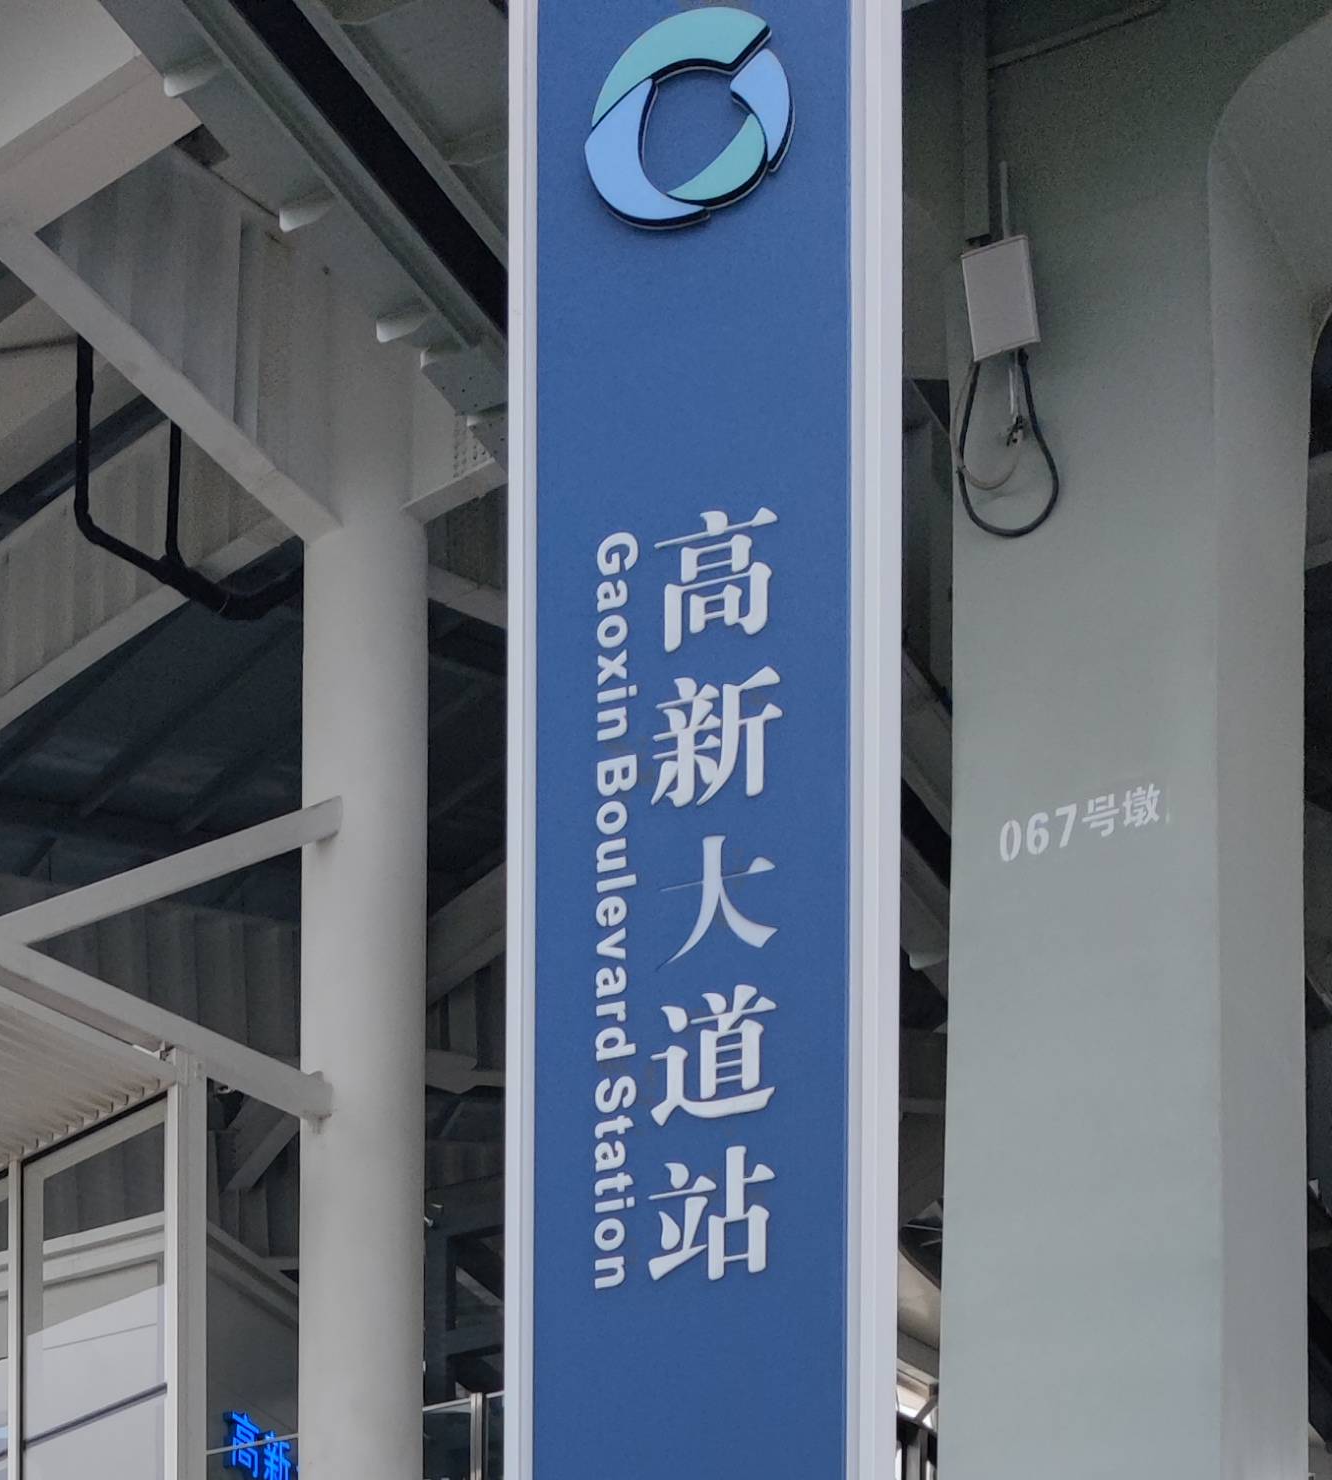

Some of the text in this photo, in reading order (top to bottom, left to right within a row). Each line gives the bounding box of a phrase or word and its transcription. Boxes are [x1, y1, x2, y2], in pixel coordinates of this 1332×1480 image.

[594, 532, 639, 1289] Gaoxin Boulevard Station
[649, 507, 783, 1281] 高新大道站
[999, 783, 1161, 862] 067号墩
